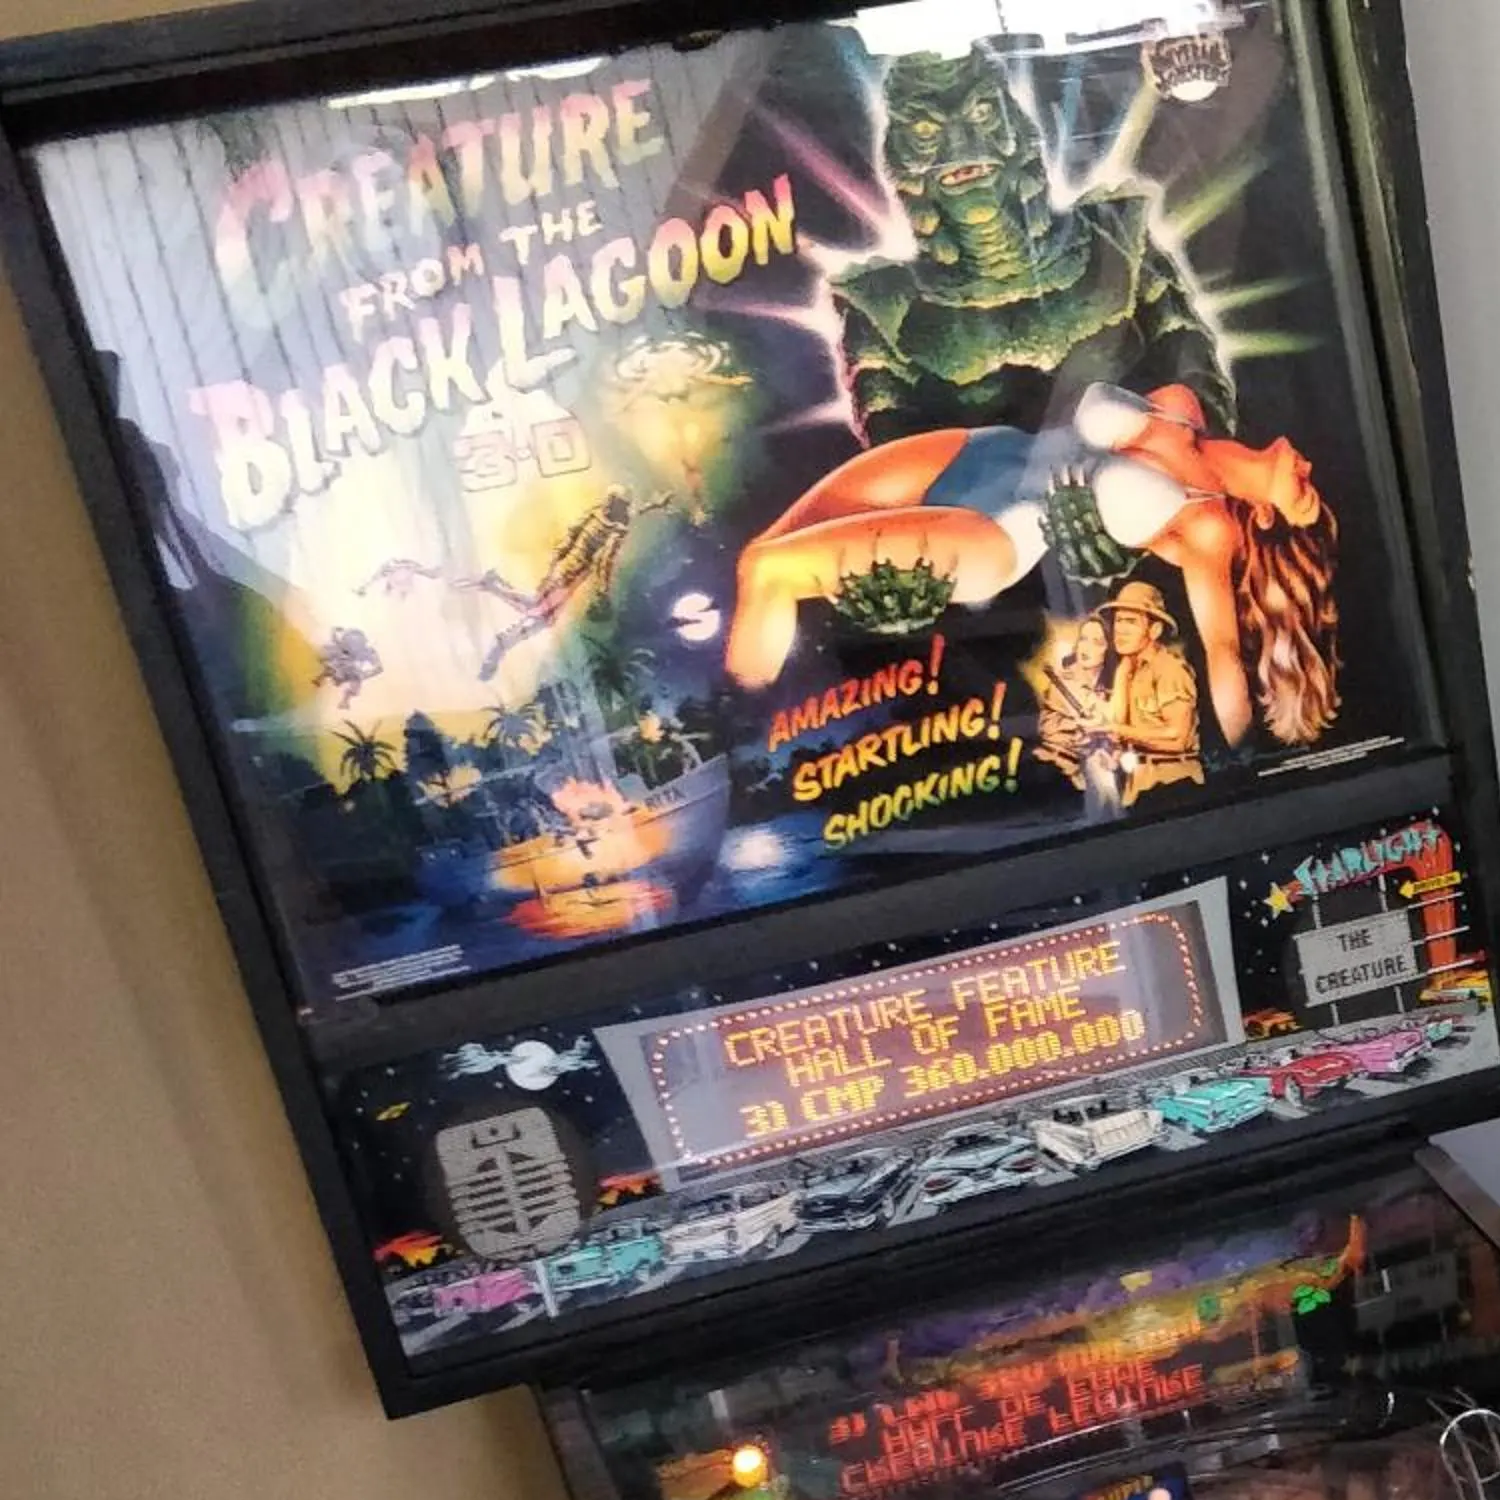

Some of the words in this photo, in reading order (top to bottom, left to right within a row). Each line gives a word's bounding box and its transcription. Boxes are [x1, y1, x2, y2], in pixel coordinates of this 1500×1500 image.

[212, 78, 665, 325] CREATURE
[340, 243, 485, 343] FROM
[499, 199, 604, 262] THE
[191, 302, 473, 532] BLACK
[486, 174, 796, 393] LAGOON
[767, 634, 945, 752] AMAZING!
[791, 681, 1006, 801] STARTLING!
[822, 737, 1024, 851] SHOCKING!
[1314, 953, 1408, 995] CREATURE
[1336, 927, 1373, 952] THE
[723, 988, 932, 1067] CREATURE
[951, 940, 1127, 1011] FEATURE
[784, 1036, 892, 1087] HALL
[911, 1016, 959, 1056] OF
[984, 986, 1087, 1037] FAME
[799, 1077, 887, 1122] CMP
